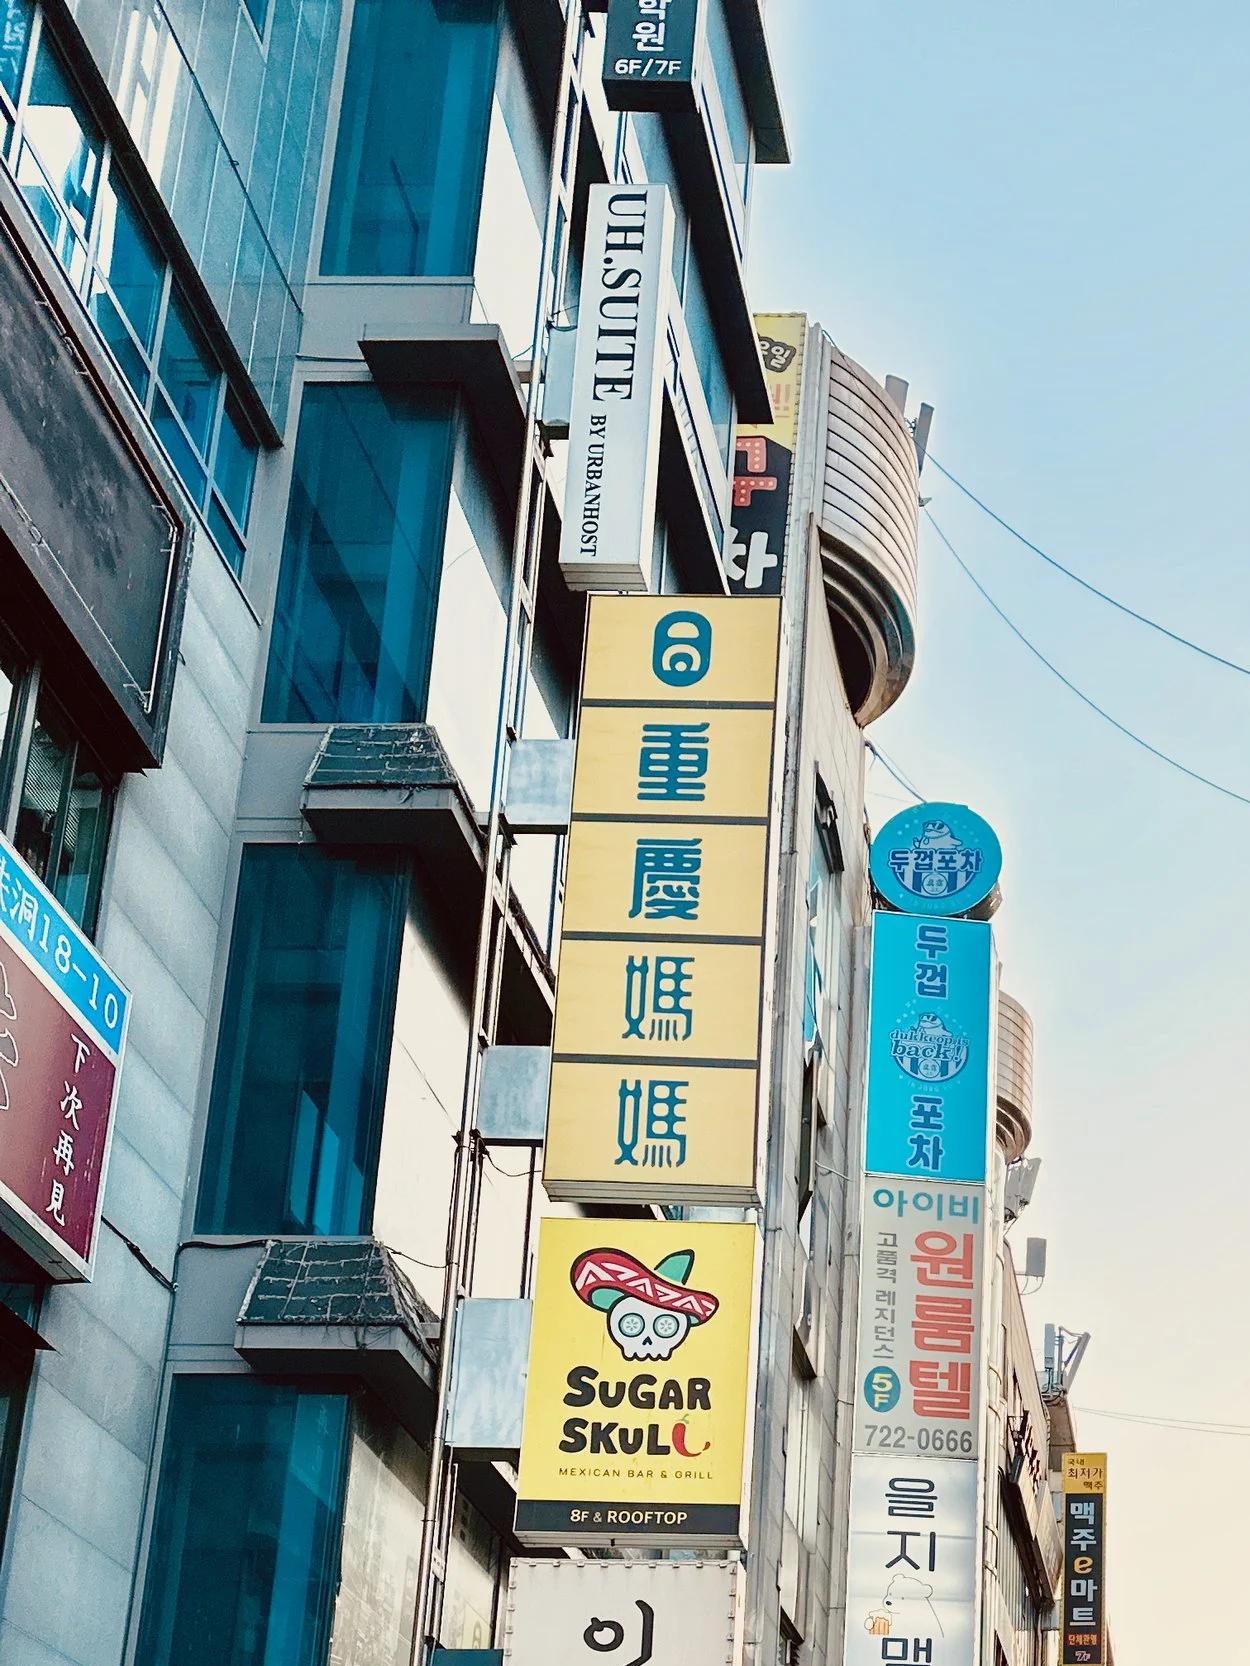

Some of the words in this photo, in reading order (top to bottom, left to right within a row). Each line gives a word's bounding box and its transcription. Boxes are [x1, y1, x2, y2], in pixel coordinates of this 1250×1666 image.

[615, 58, 682, 77] 6F/7F
[593, 189, 649, 402] UH.SUITE
[590, 414, 606, 437] BY
[580, 442, 605, 557] URBANHOST
[887, 847, 984, 873] 두껍포차
[614, 722, 711, 1168] 重慶媽媽
[915, 925, 948, 999] 두껍
[890, 1039, 965, 1062] back!
[44, 1033, 91, 1227] 下次再見
[908, 1094, 948, 1172] 포차
[872, 1187, 980, 1225] 아이비
[874, 1231, 900, 1285] 고품격
[871, 1288, 898, 1361] 레지던스
[909, 1229, 976, 1421] 원룸텔
[870, 1372, 894, 1409] 5F
[863, 1423, 974, 1455] 722-0666
[558, 1466, 621, 1478] MEXICAN
[626, 1468, 655, 1479] BAR
[660, 1470, 669, 1479] &
[674, 1470, 714, 1480] GRILL
[1067, 1467, 1104, 1480] 최저가
[570, 1508, 589, 1523] 8F
[606, 1509, 689, 1525] ROOFTOP
[884, 1475, 940, 1573] 을지
[1069, 1501, 1098, 1627] 맥주e마트
